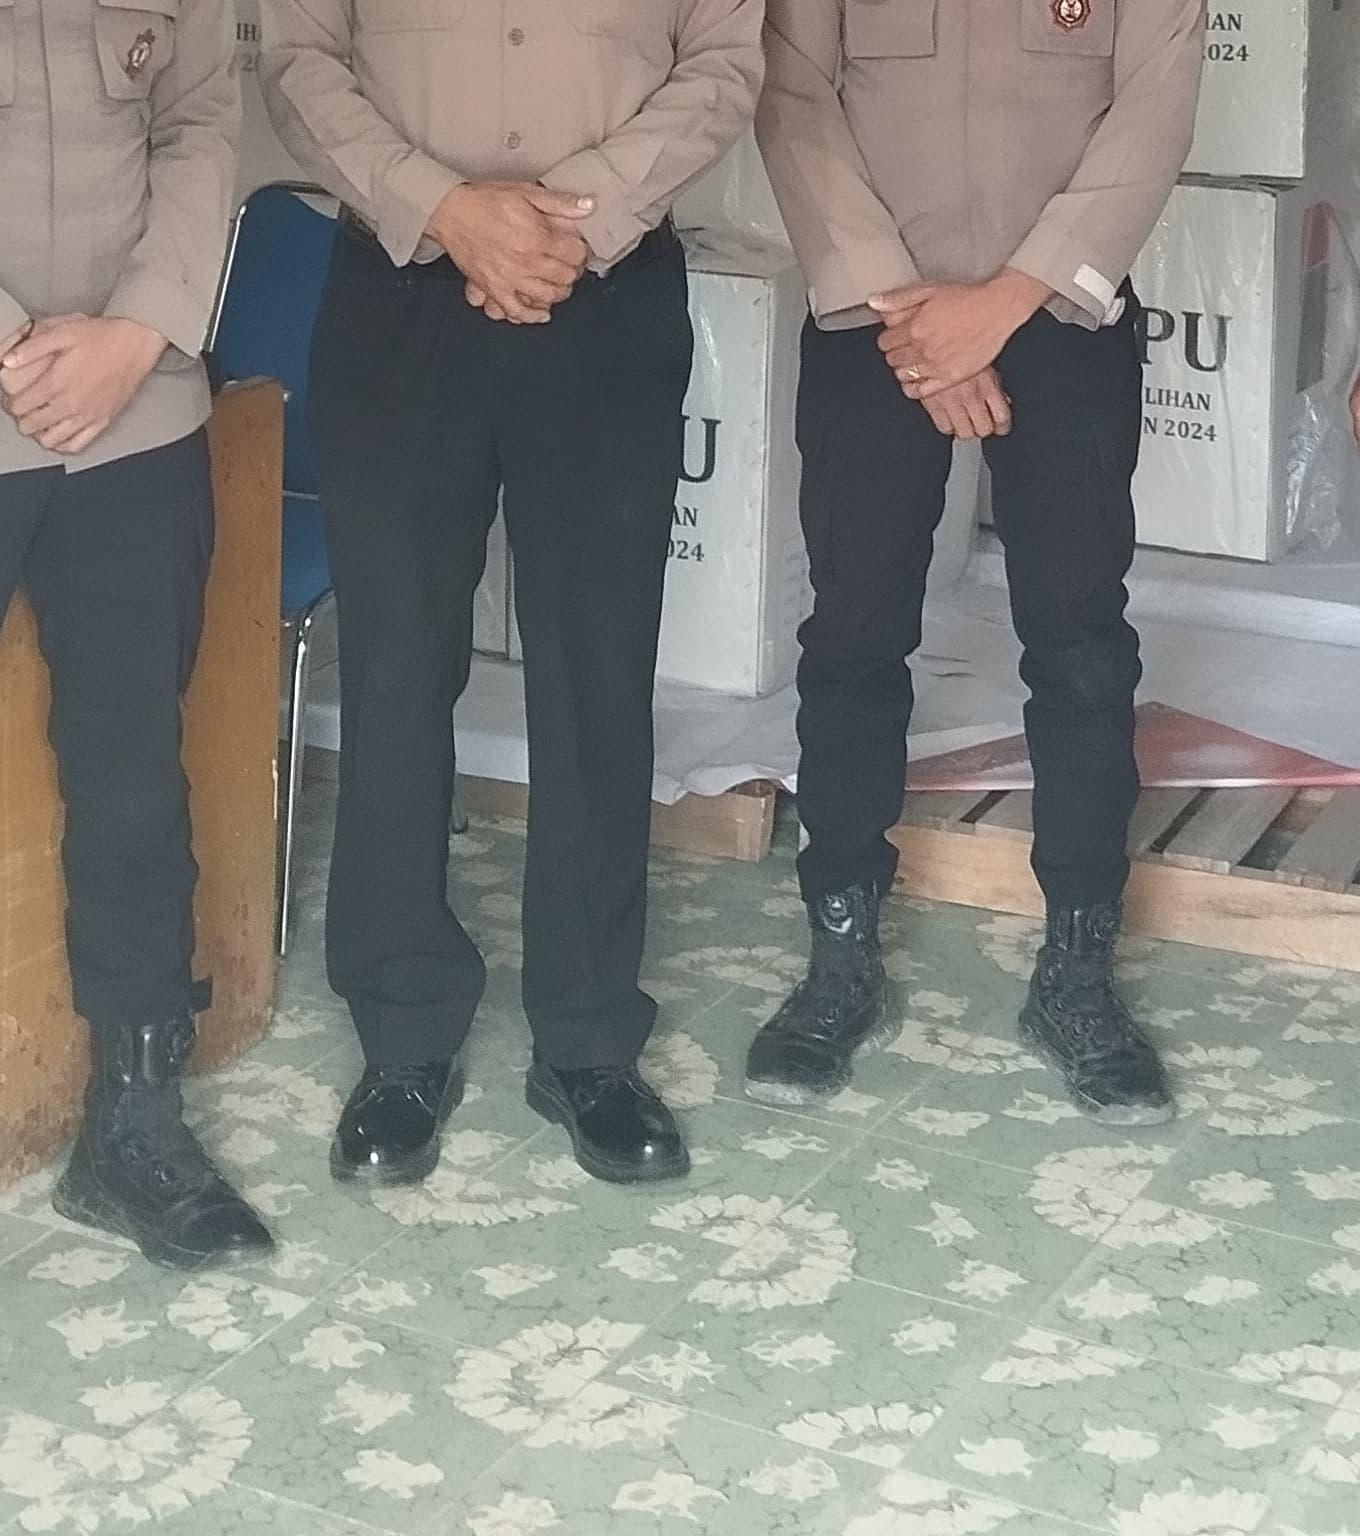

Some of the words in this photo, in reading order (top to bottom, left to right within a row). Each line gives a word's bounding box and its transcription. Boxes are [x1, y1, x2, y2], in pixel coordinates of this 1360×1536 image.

[1203, 43, 1250, 62] 024
[1140, 306, 1234, 373] PU
[1143, 385, 1212, 412] LIHAN
[1163, 418, 1218, 443] 2024
